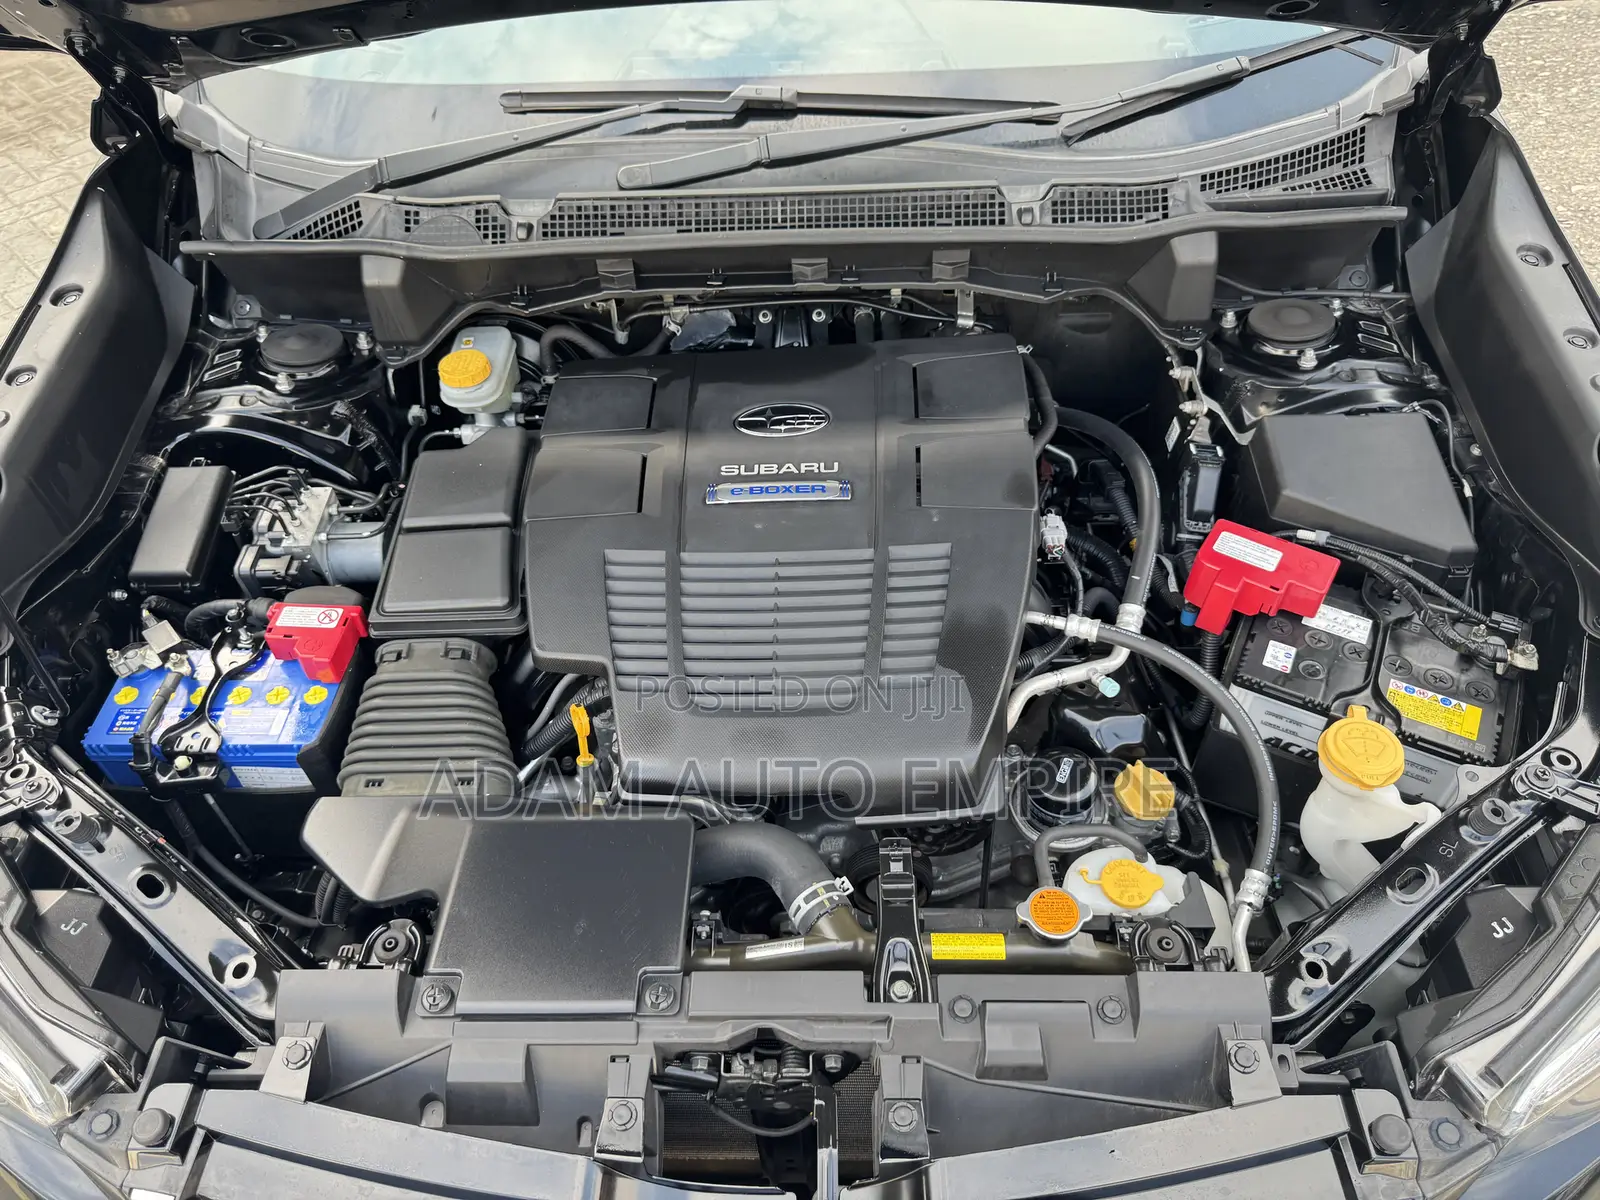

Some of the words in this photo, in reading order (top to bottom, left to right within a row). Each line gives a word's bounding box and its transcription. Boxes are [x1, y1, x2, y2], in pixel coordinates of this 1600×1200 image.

[720, 461, 839, 476] SUBARU
[730, 484, 827, 496] e-BOXER
[1264, 710, 1284, 721] UPPER
[1285, 718, 1303, 728] LEVEL
[1282, 727, 1299, 736] LEVEL
[1438, 839, 1459, 858] SL
[60, 917, 88, 936] JJ
[1491, 916, 1515, 939] JJ
